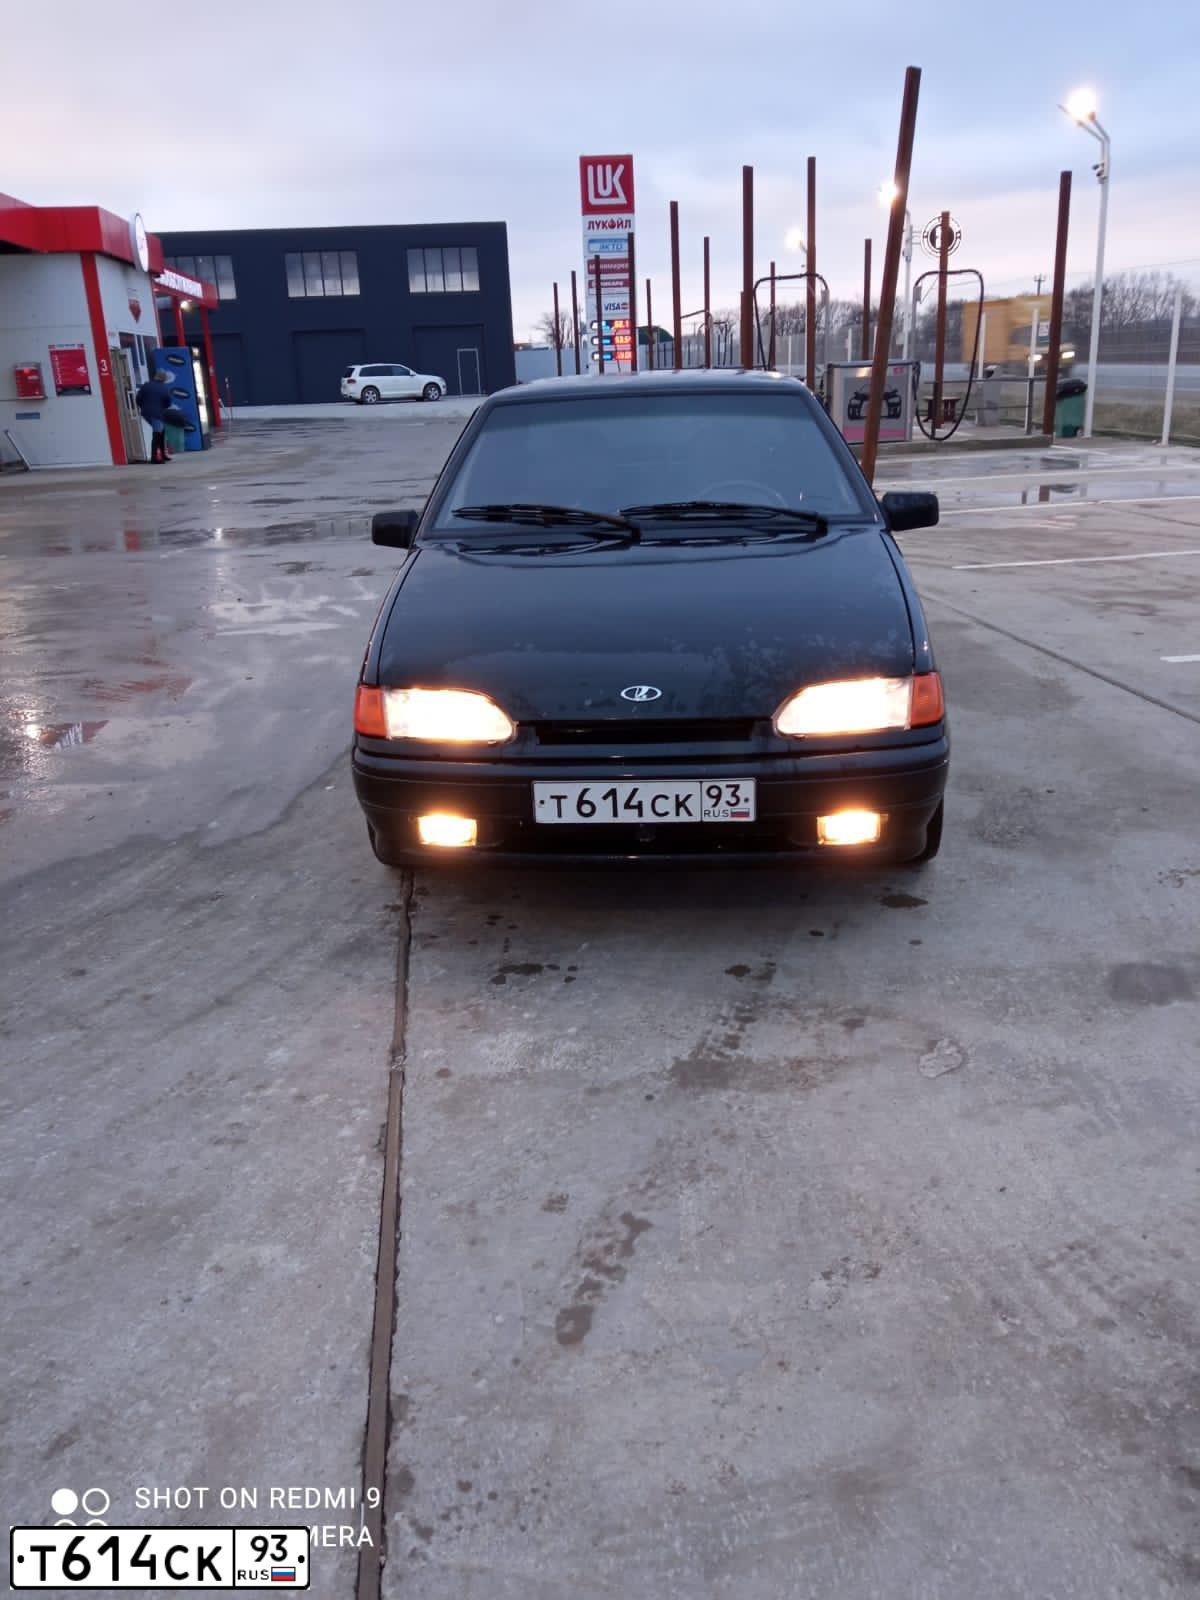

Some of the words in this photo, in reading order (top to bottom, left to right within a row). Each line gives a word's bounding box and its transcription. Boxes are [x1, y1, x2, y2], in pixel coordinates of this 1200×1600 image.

[587, 217, 631, 230] ЛУКОЙЛ
[550, 787, 694, 818] Т614СК
[706, 784, 741, 808] 93
[704, 809, 729, 818] RUS
